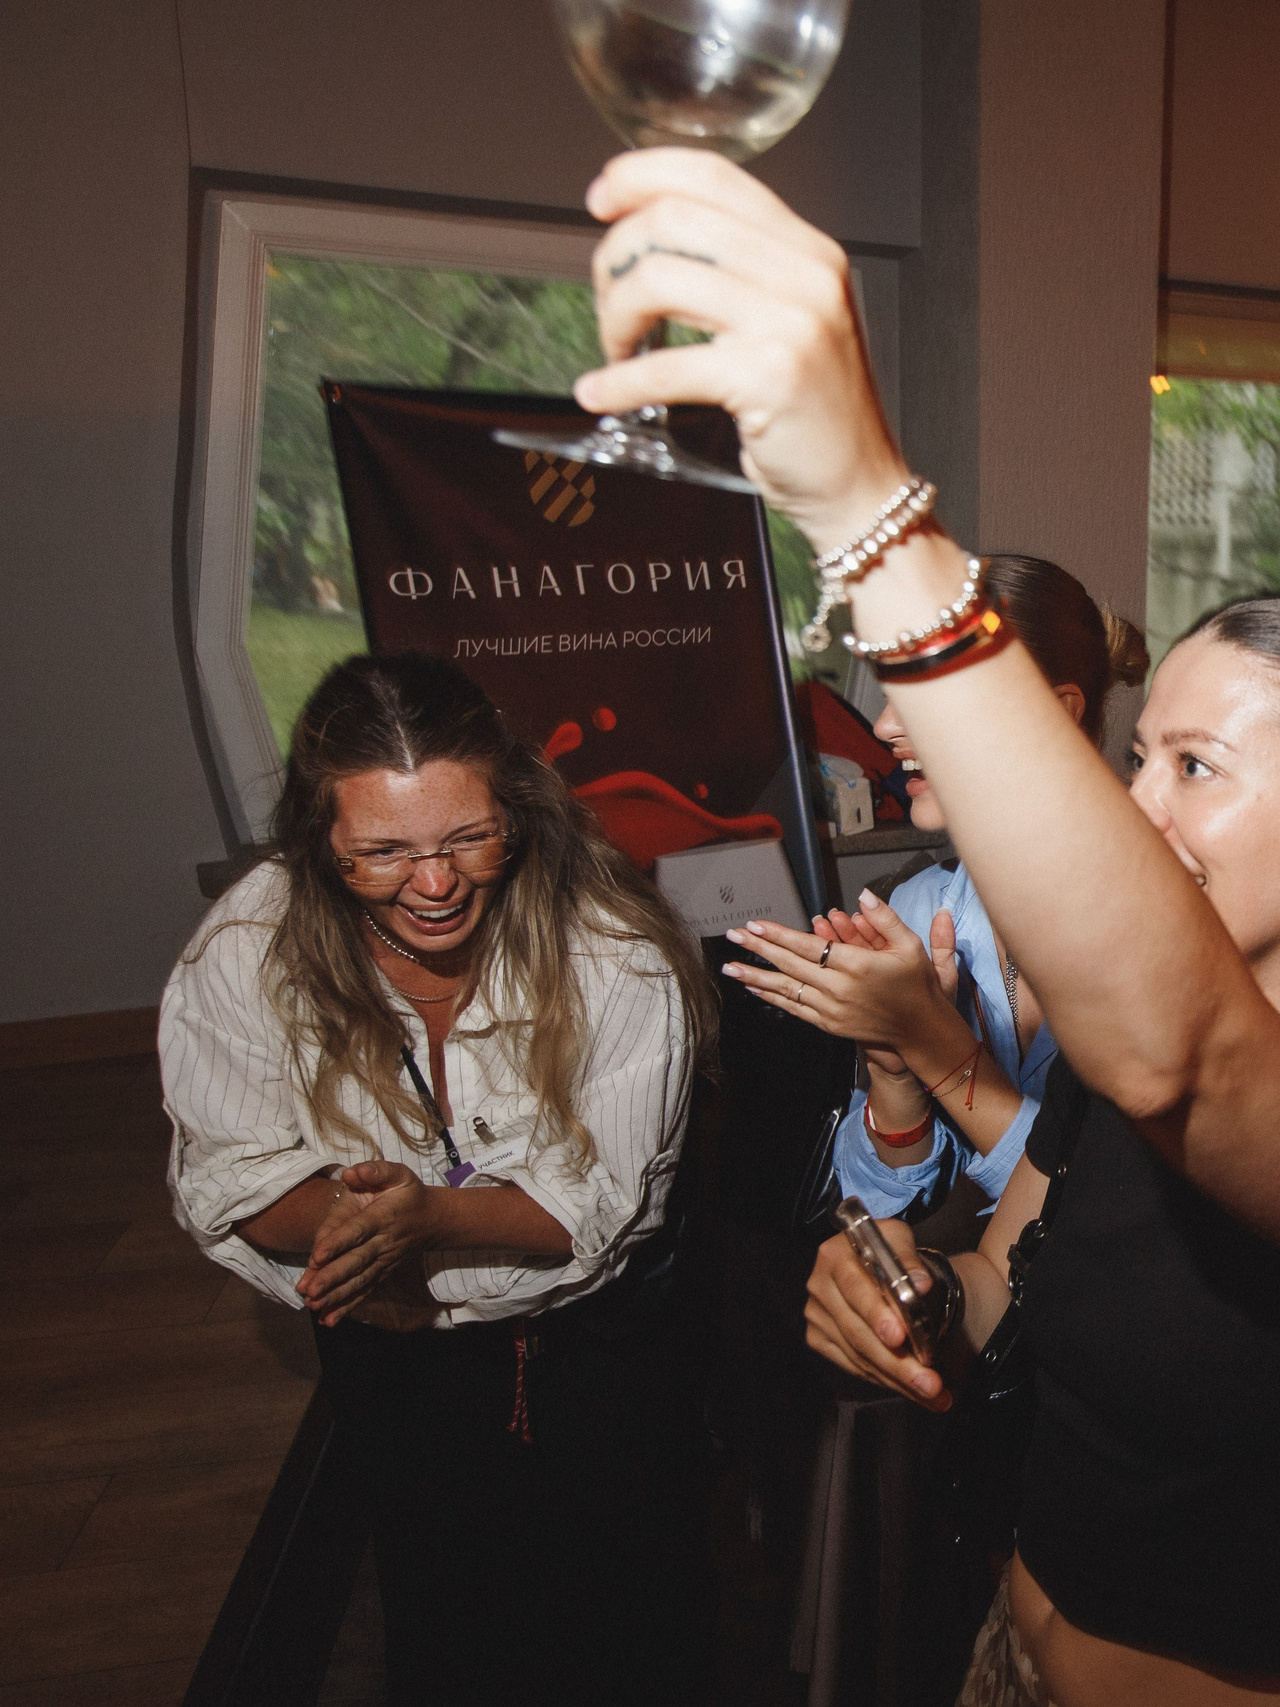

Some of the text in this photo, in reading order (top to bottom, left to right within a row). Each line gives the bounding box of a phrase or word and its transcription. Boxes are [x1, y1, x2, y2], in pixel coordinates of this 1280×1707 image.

[388, 559, 747, 600] ФАНАГОРИЯ
[454, 626, 712, 658] ЛУЧШИЕ ВИНА РОССИИ
[478, 1151, 514, 1170] УЧАСТНИК
